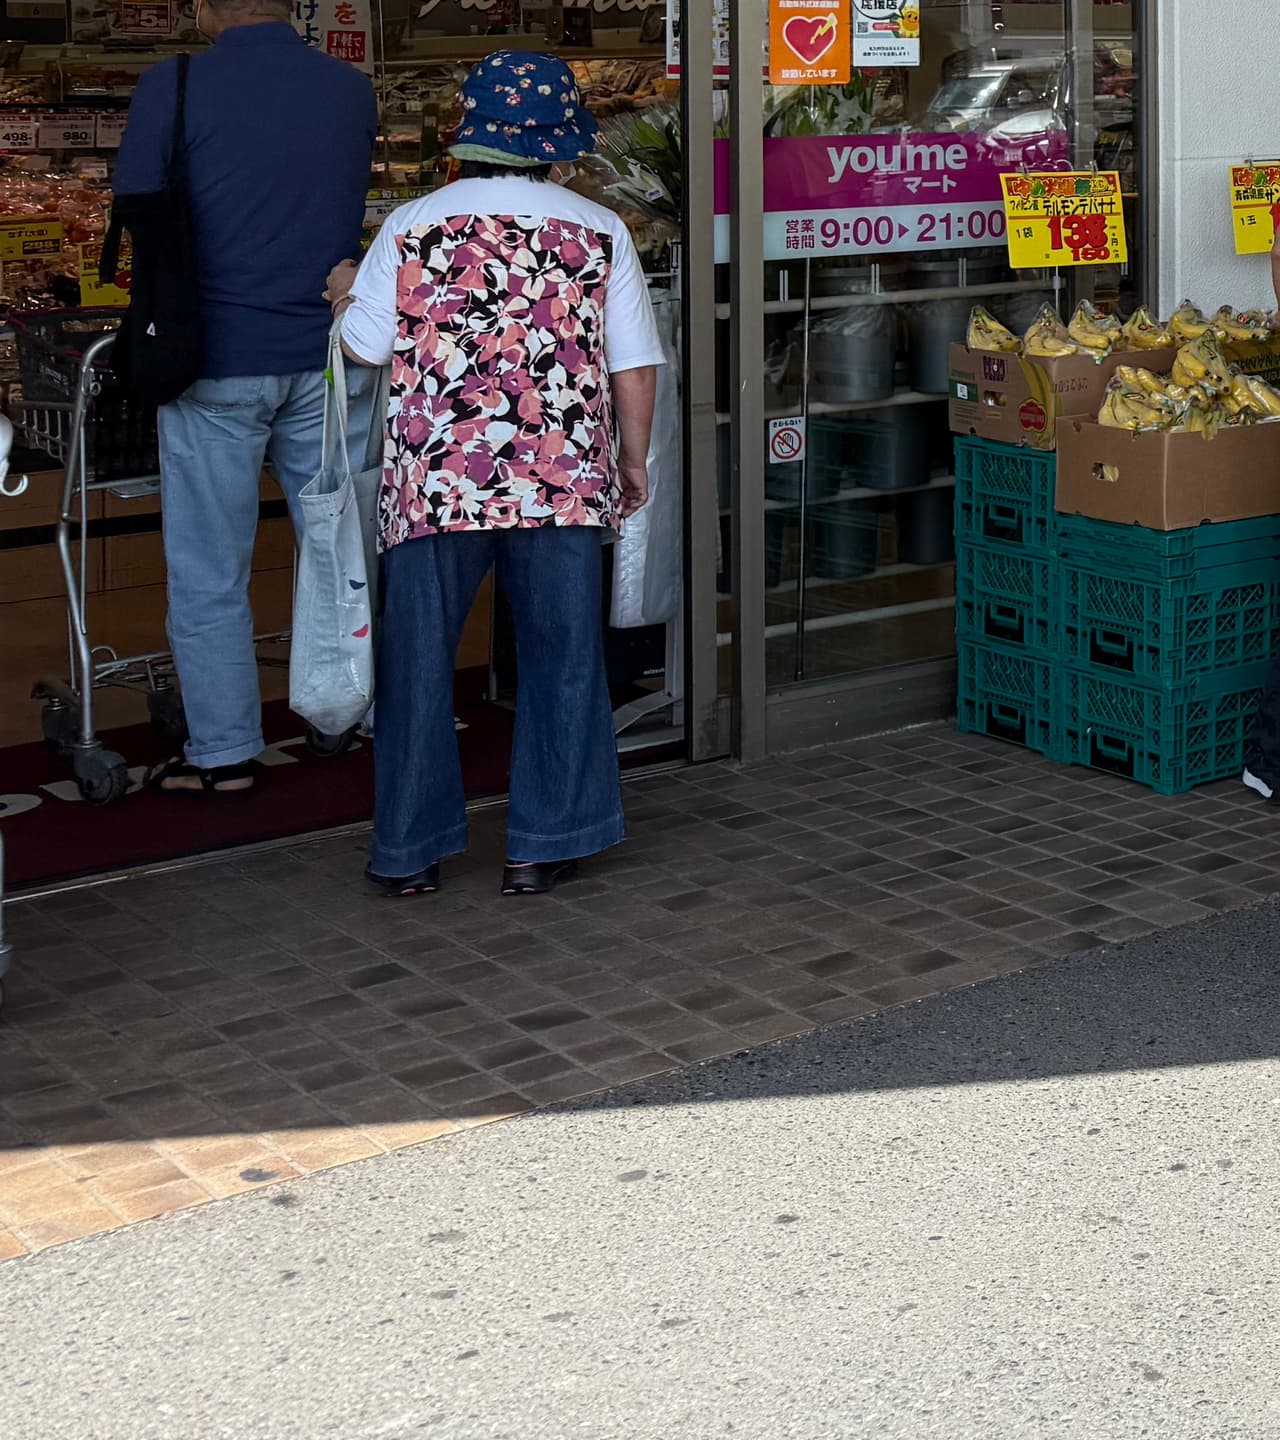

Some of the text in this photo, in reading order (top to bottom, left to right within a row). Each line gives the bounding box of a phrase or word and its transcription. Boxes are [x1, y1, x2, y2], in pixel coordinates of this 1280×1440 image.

[904, 176, 958, 194] マート
[1043, 197, 1116, 216] デルモンテバナナ
[785, 219, 815, 233] 営業
[820, 210, 1006, 249] 9:00 21:00
[1048, 214, 1108, 250] 138
[785, 235, 815, 250] 時間
